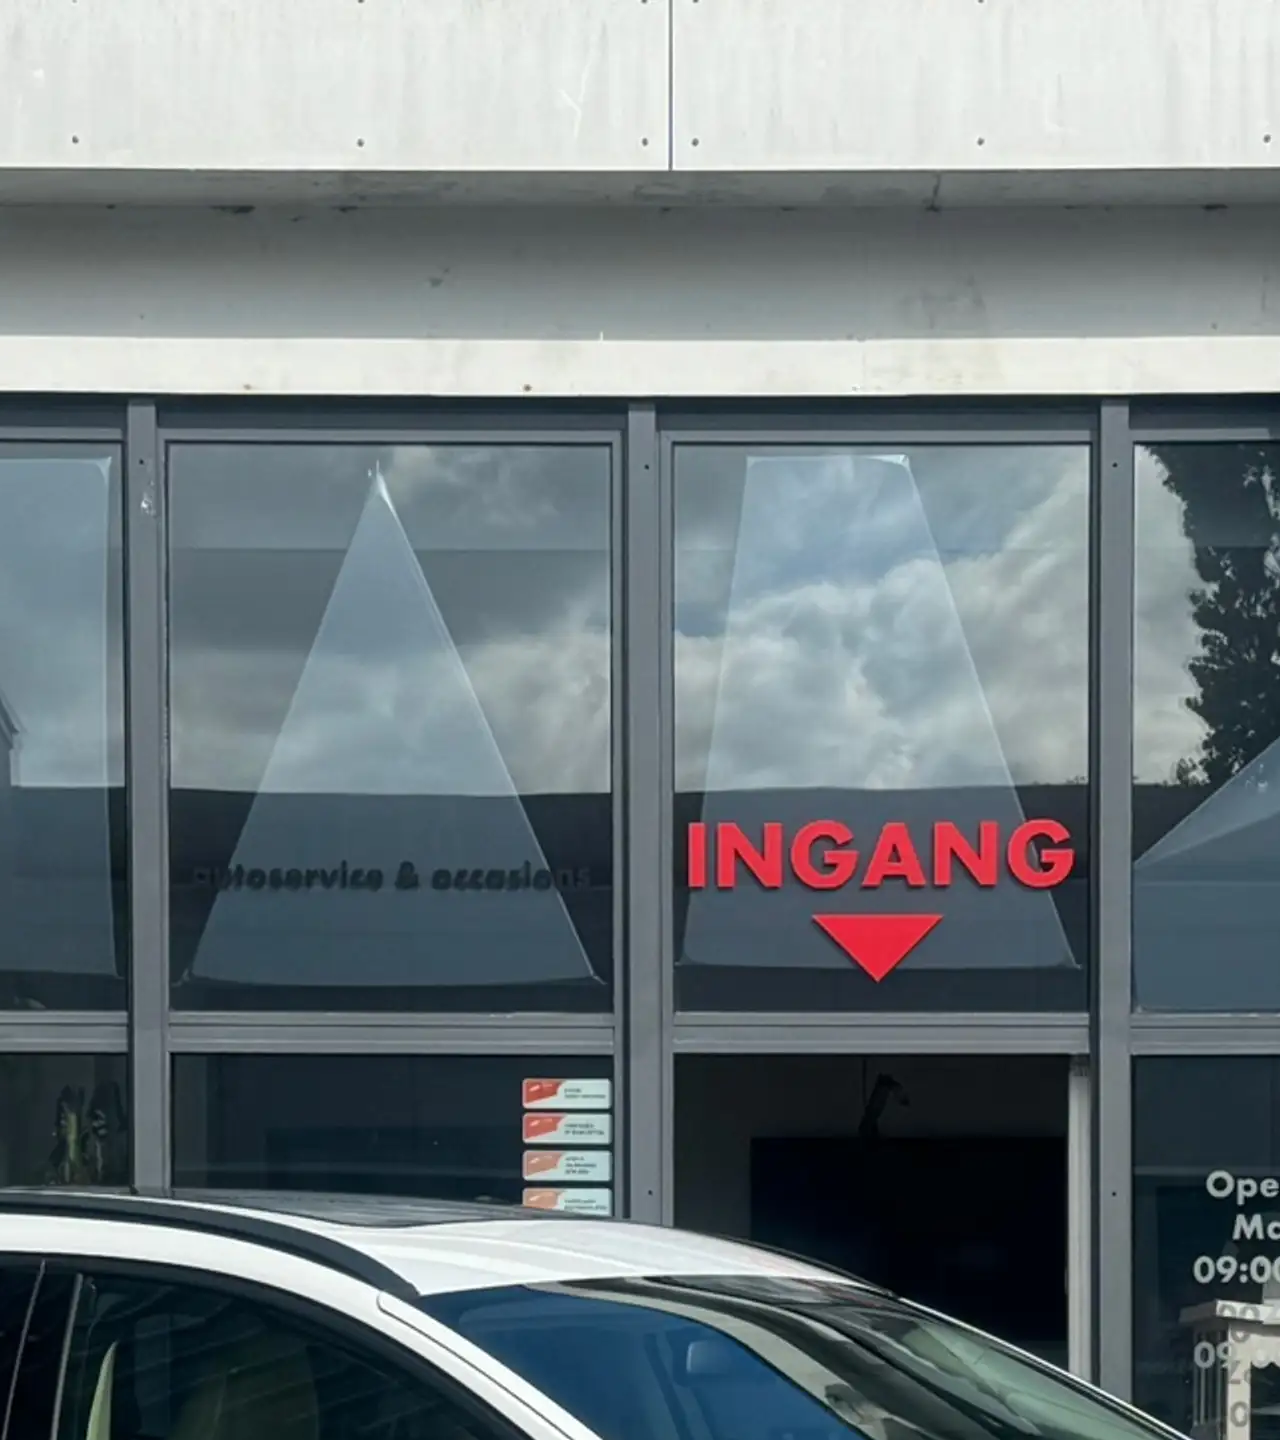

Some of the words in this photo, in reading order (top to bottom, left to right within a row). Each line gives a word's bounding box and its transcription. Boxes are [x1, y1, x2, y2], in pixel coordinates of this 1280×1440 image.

[193, 860, 385, 892] autoservice
[394, 860, 420, 891] &
[431, 860, 591, 892] occasions
[687, 819, 1075, 889] INGANG
